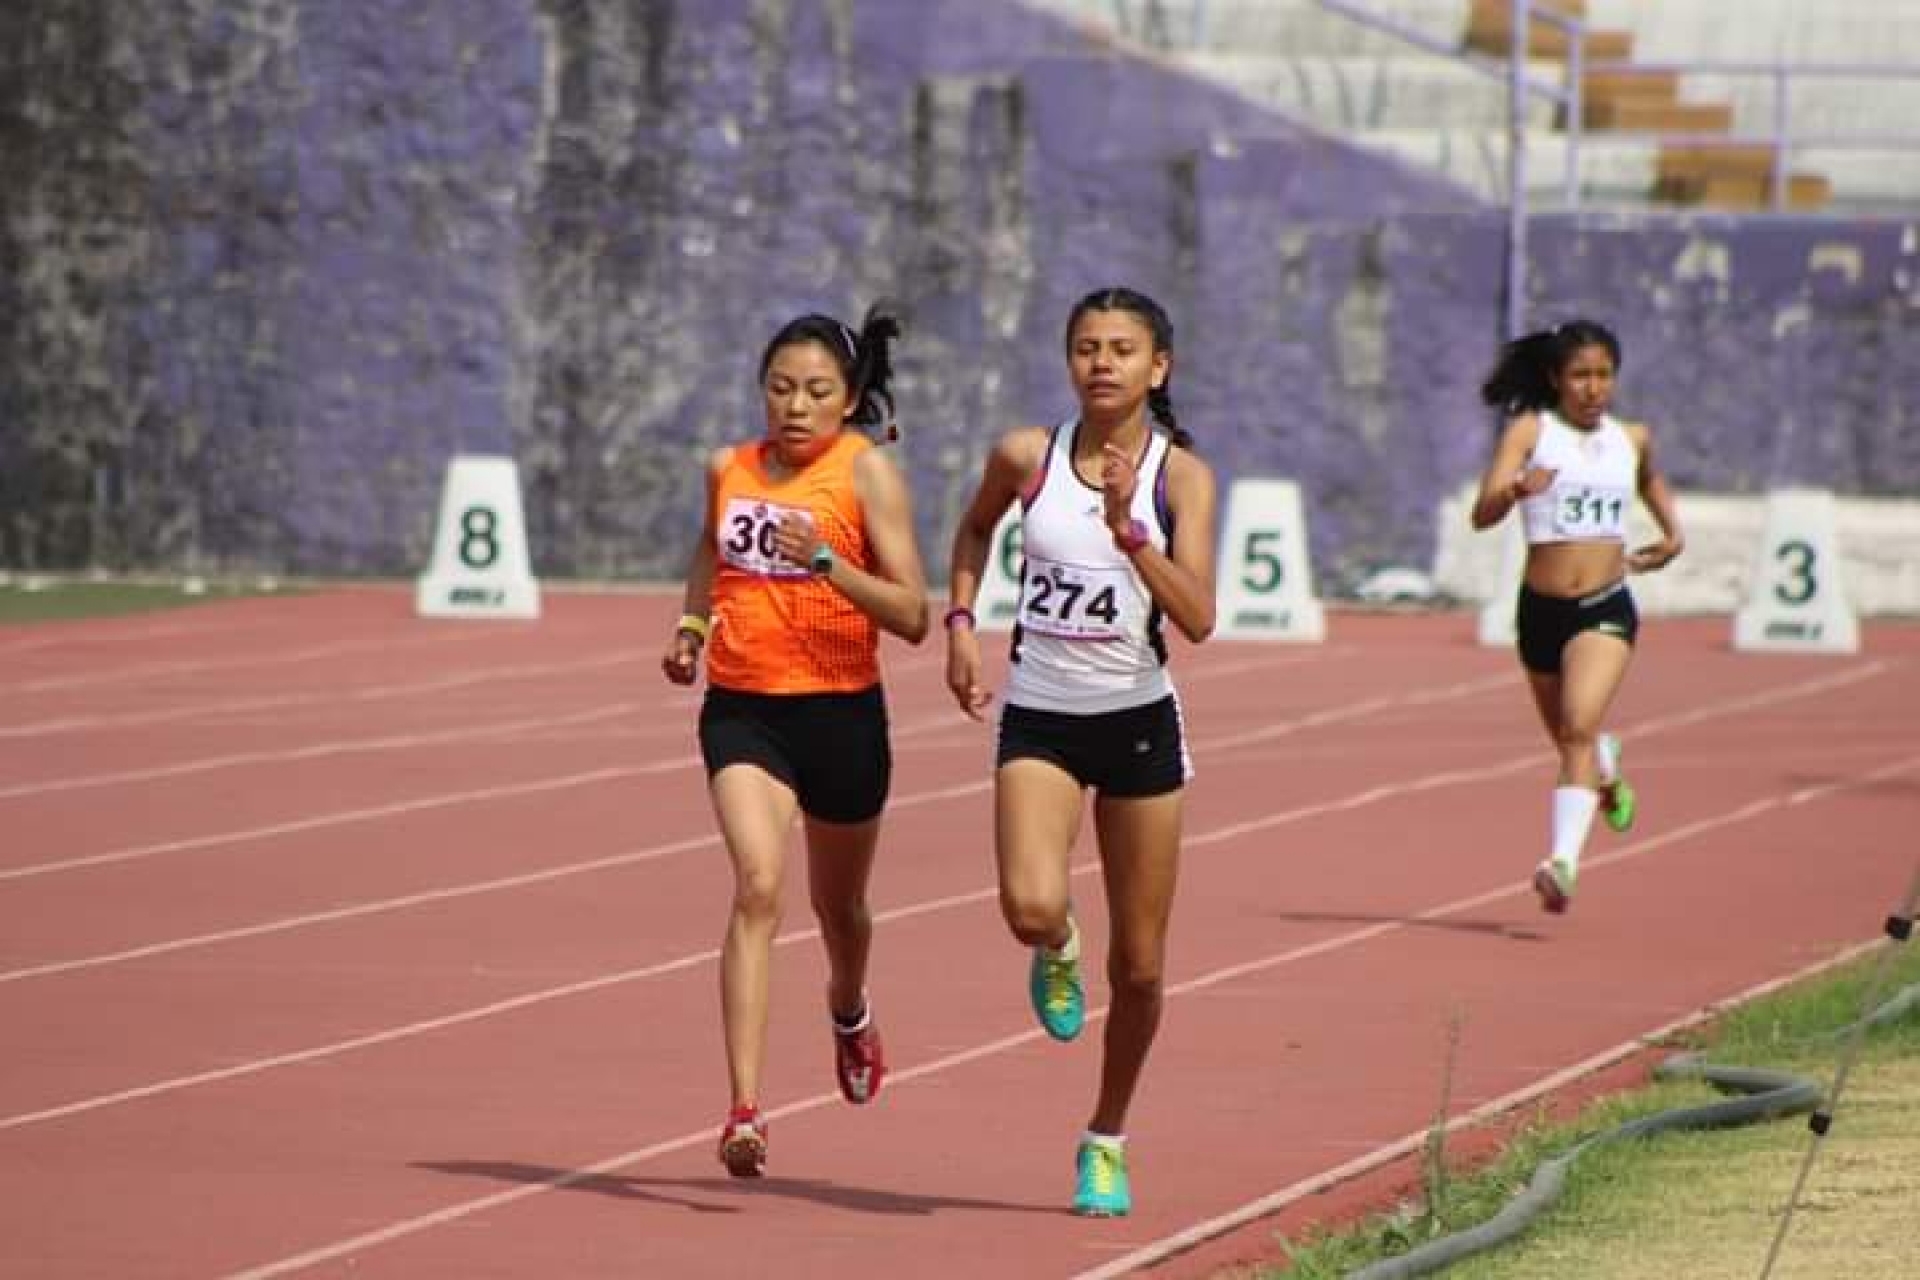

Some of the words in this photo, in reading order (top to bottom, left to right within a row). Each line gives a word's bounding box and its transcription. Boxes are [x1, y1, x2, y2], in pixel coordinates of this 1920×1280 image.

[460, 504, 500, 569] 8
[727, 514, 789, 560] 30
[1564, 496, 1622, 524] 311
[1242, 530, 1283, 594] 5
[1775, 540, 1816, 606] 3
[1026, 575, 1119, 624] 274
